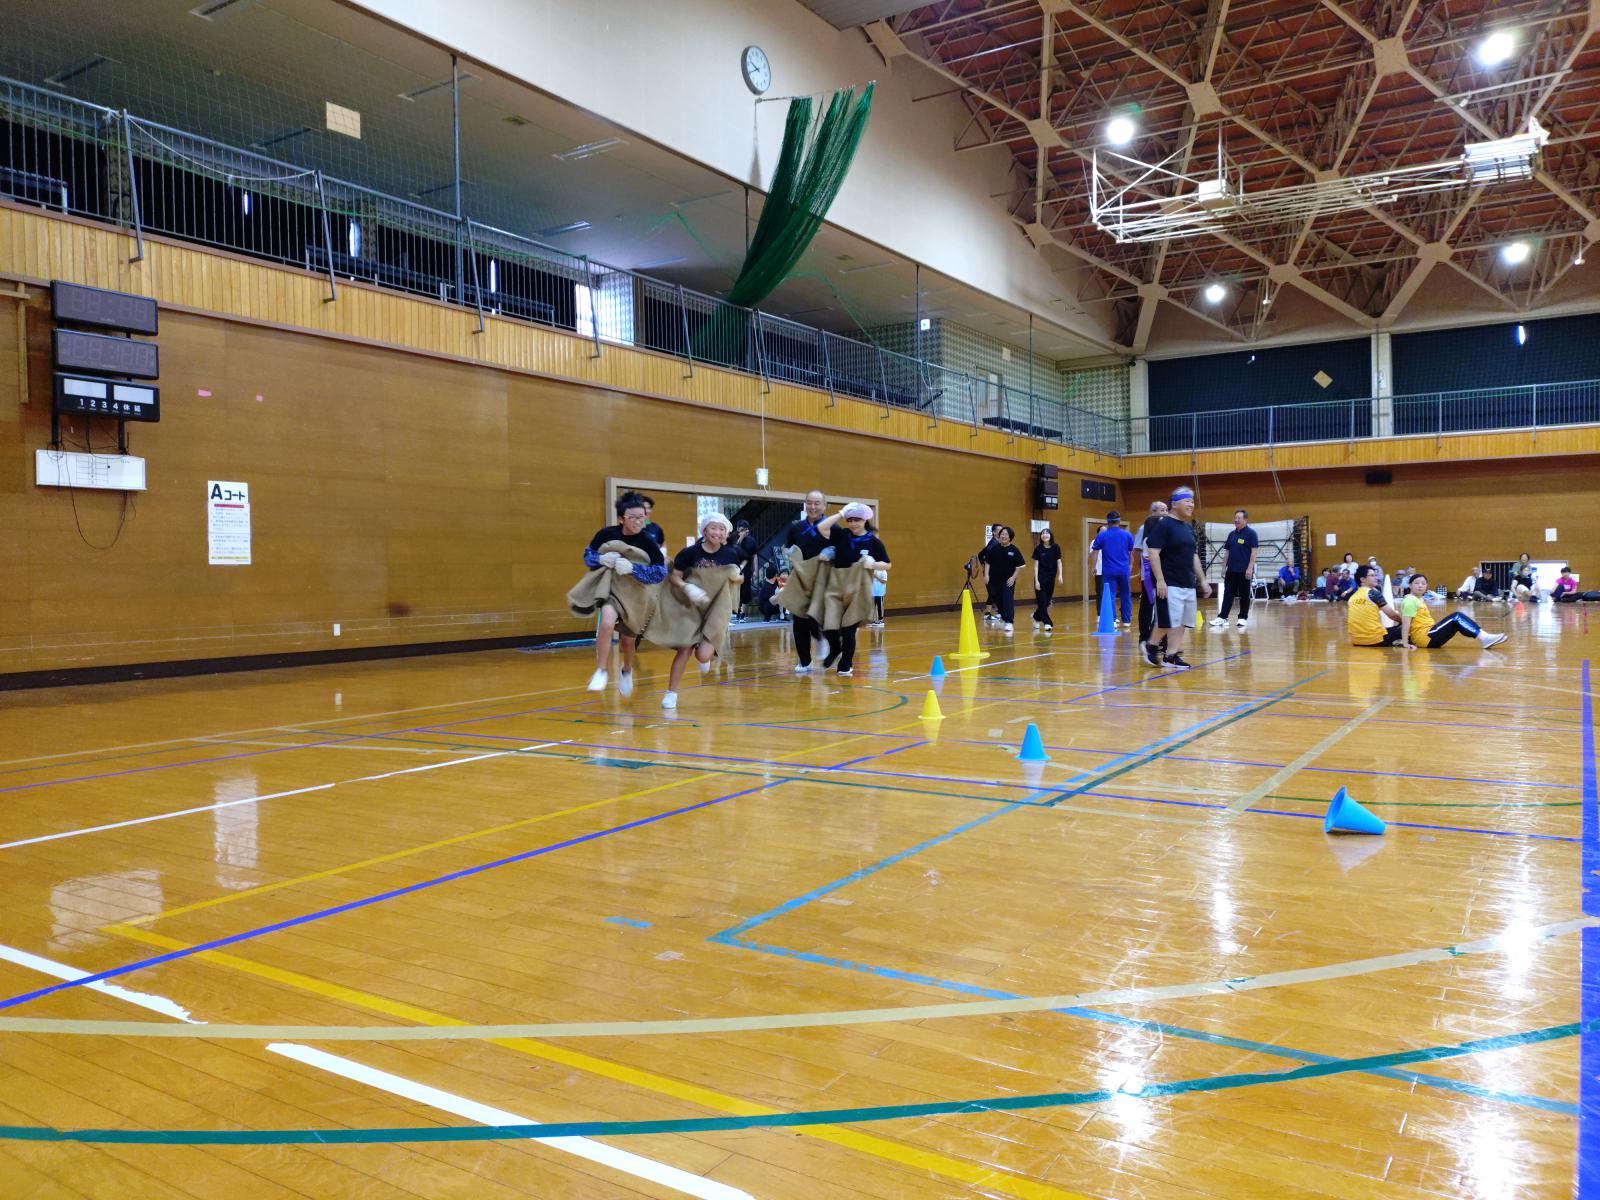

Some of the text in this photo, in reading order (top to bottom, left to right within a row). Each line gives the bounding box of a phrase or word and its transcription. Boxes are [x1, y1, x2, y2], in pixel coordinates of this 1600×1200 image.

[80, 398, 84, 406] 1
[90, 400, 96, 408] 2
[113, 402, 119, 410] 4
